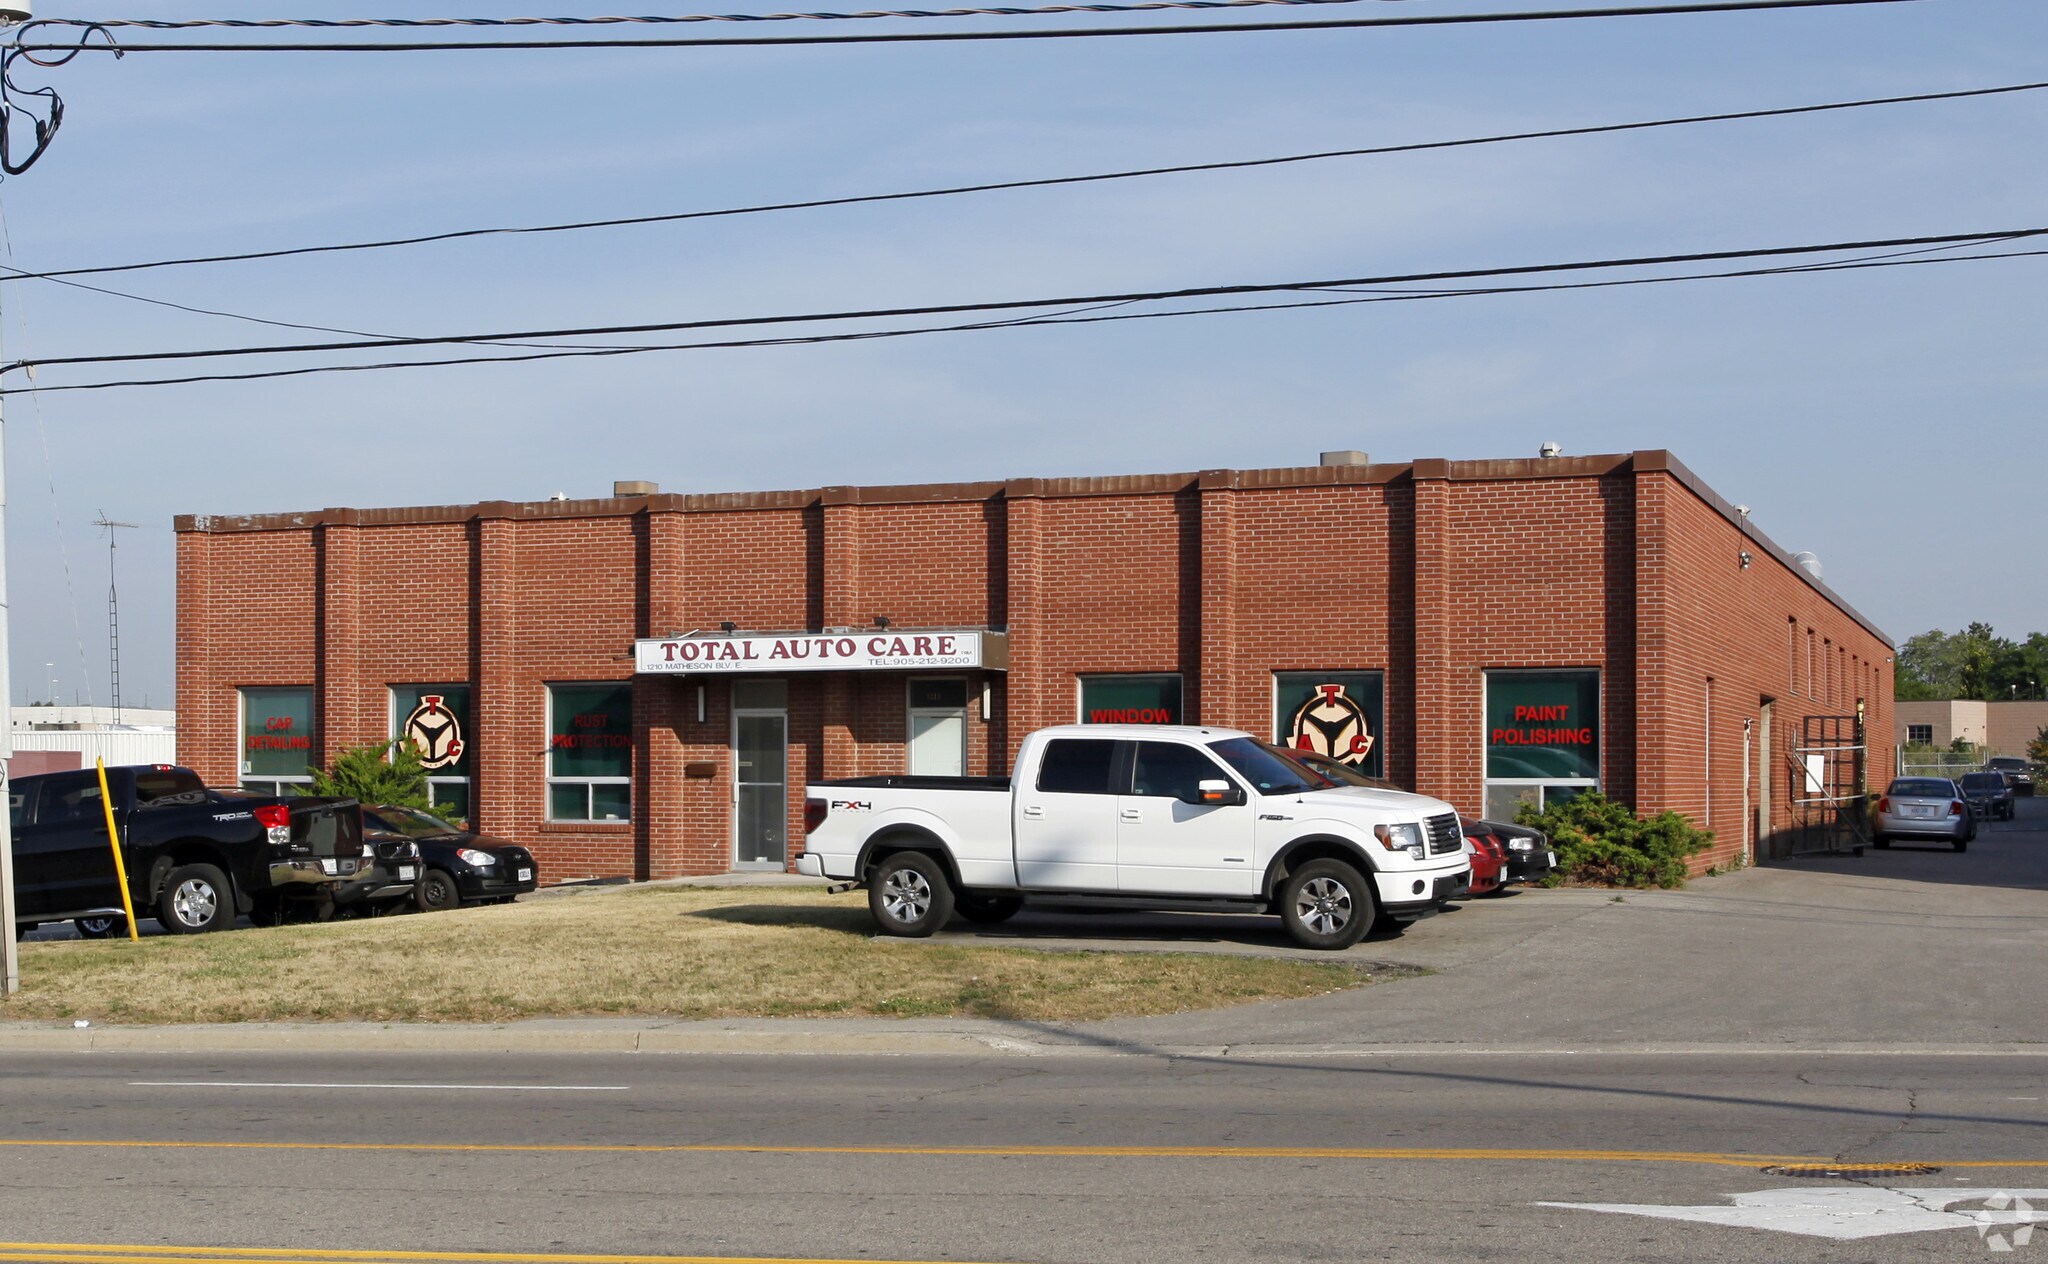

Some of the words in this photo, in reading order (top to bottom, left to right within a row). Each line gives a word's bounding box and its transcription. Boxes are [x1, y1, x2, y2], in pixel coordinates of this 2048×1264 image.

[660, 641, 759, 661] TOTAL
[768, 638, 857, 660] AUTO
[867, 636, 957, 657] CARE
[665, 662, 713, 670] MATHESON
[575, 713, 608, 727] RUST
[1090, 708, 1169, 724] WINDOW
[1515, 705, 1569, 721] PAINT
[265, 716, 293, 730] CAR
[247, 736, 311, 749] DETAILING
[552, 733, 632, 748] PROTECTION
[1492, 728, 1592, 744] POLISHING
[831, 801, 872, 810] FX4
